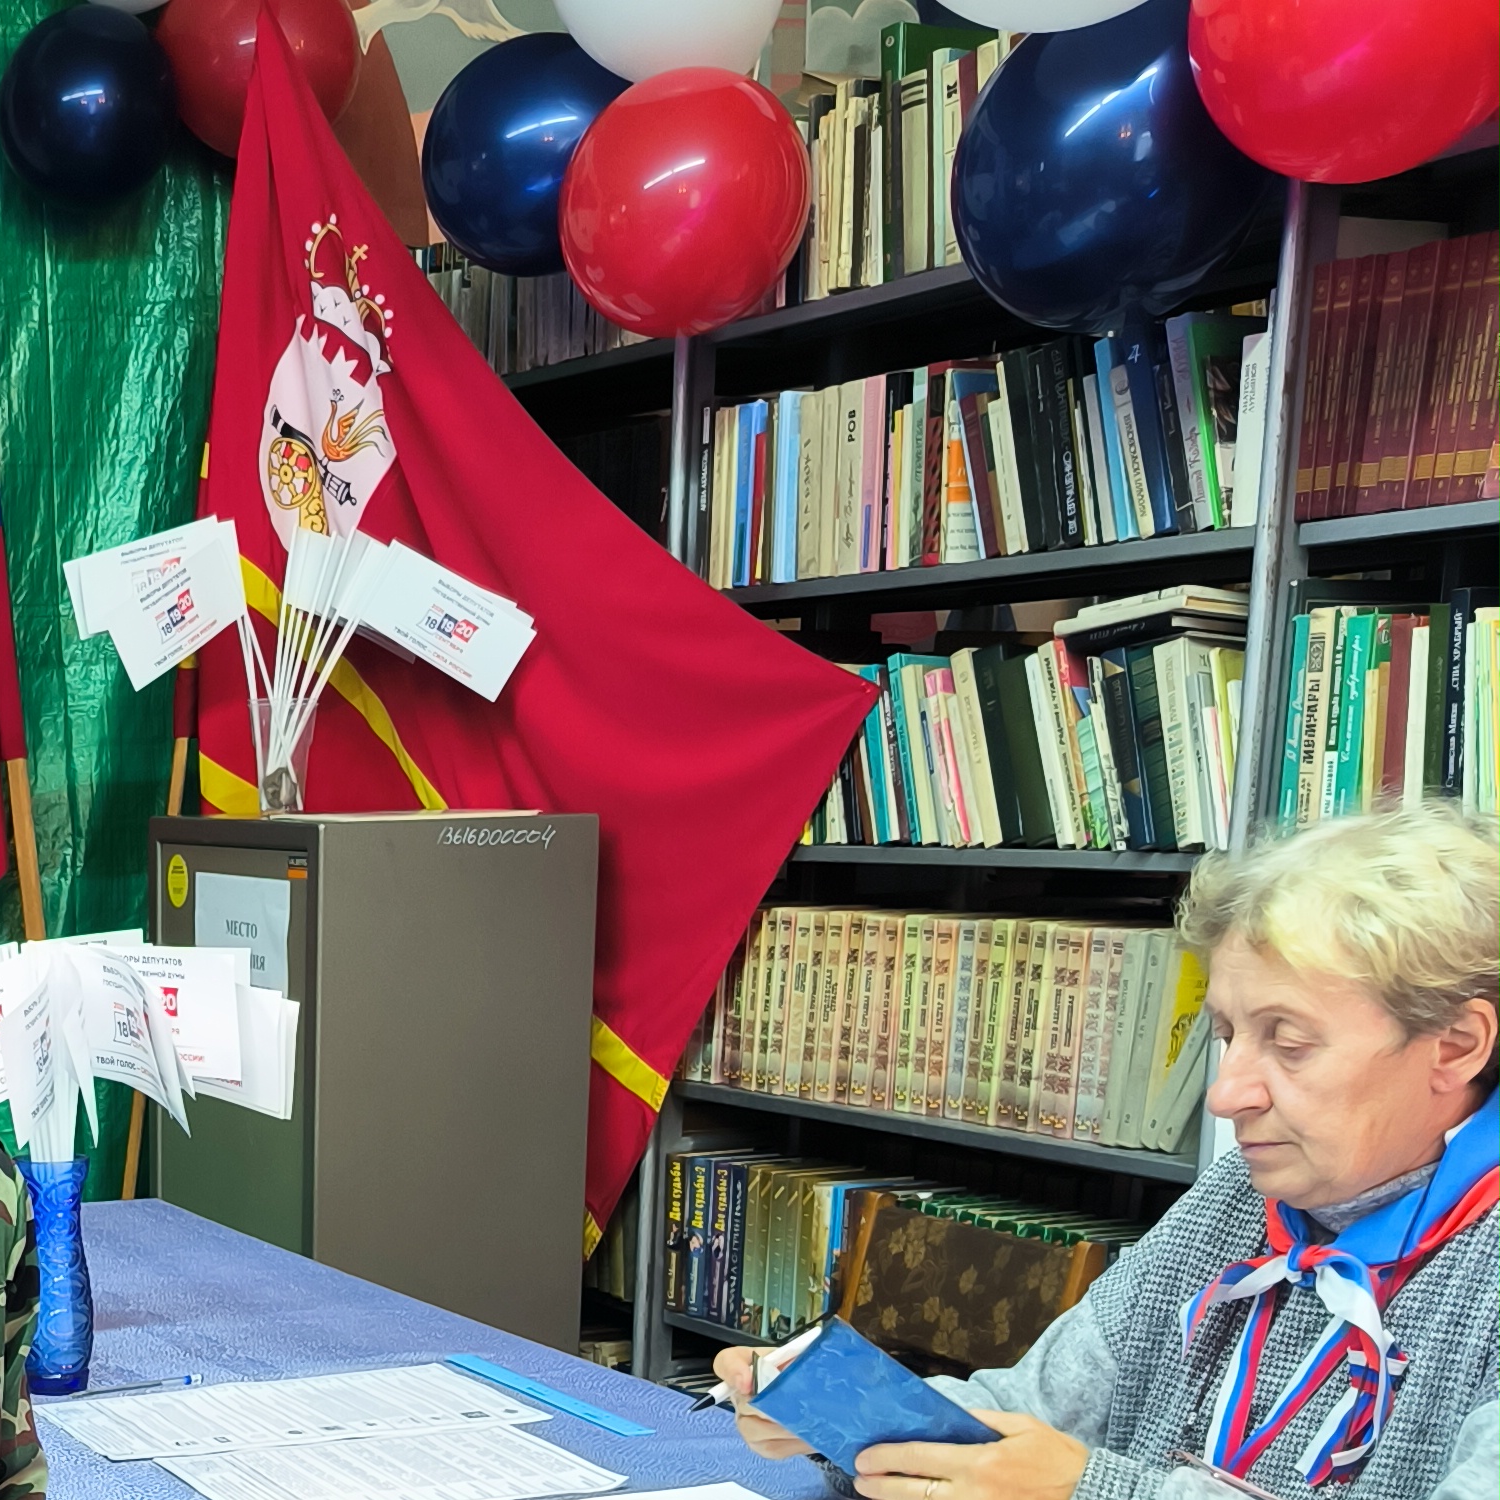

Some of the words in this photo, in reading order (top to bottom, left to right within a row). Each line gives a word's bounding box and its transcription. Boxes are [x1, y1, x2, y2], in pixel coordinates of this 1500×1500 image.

[847, 409, 856, 442] РОВ
[179, 594, 192, 611] 20
[168, 608, 182, 623] 19
[425, 616, 438, 629] 18
[161, 622, 173, 636] 18
[440, 618, 454, 632] 19
[456, 623, 474, 638] 20
[1302, 679, 1320, 765] МЕМУАРЫ
[437, 824, 556, 850] 13616000004
[225, 919, 258, 939] МЕСТО
[141, 956, 183, 966] ДЕПУТАТОВ
[823, 968, 833, 1023] КОРОЛЕВСКАЯ
[117, 1020, 129, 1038] 18
[96, 1055, 116, 1066] ТВОЙ
[116, 1058, 137, 1071] ГОЛОС
[179, 1053, 205, 1063] ОССИИ!
[670, 1161, 683, 1199] судьбы
[668, 1200, 682, 1221] Две
[691, 1210, 704, 1229] Две
[714, 1213, 726, 1232] Две
